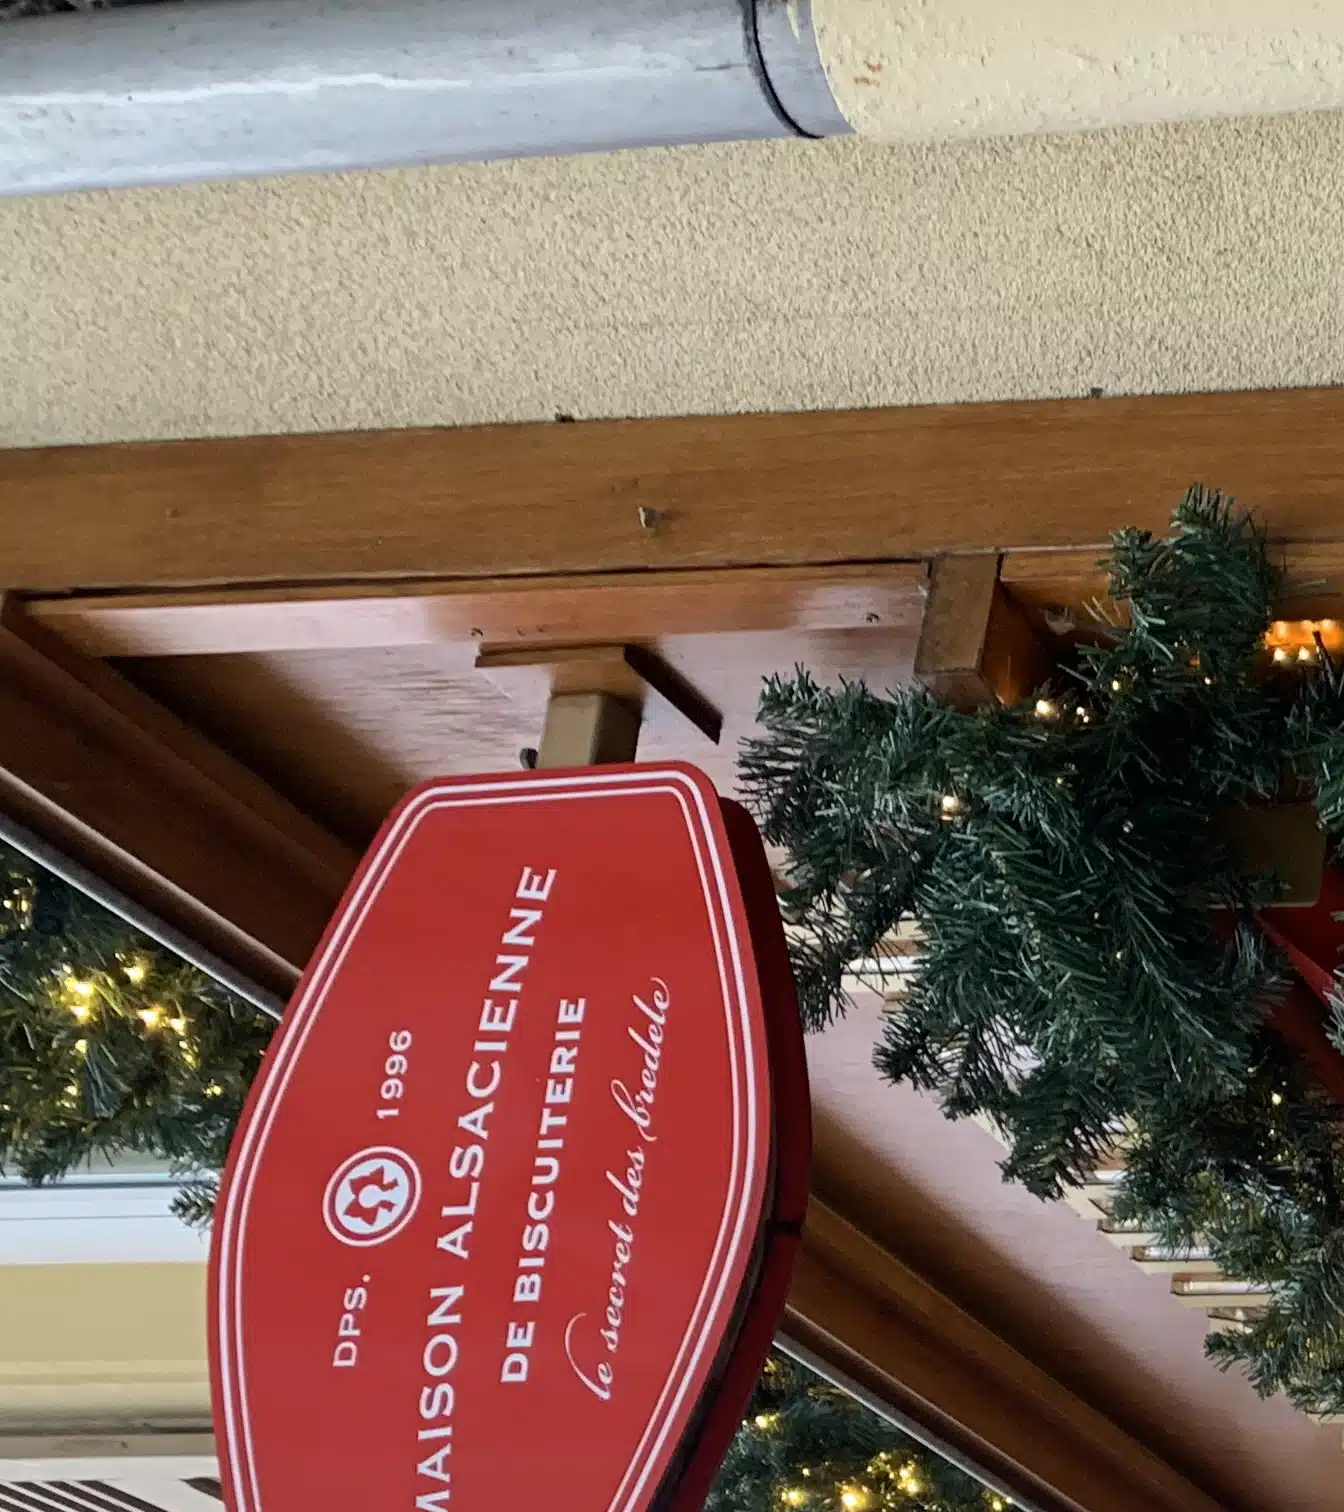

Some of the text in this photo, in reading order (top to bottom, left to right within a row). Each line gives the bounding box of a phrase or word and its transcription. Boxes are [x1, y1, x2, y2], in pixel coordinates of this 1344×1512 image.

[376, 1030, 413, 1120] 1996
[436, 866, 557, 1260] ALSACIENNE
[500, 997, 587, 1383] DE BISCUITERIE
[564, 976, 670, 1401] le secret des bredele
[332, 1274, 371, 1367] DPS.
